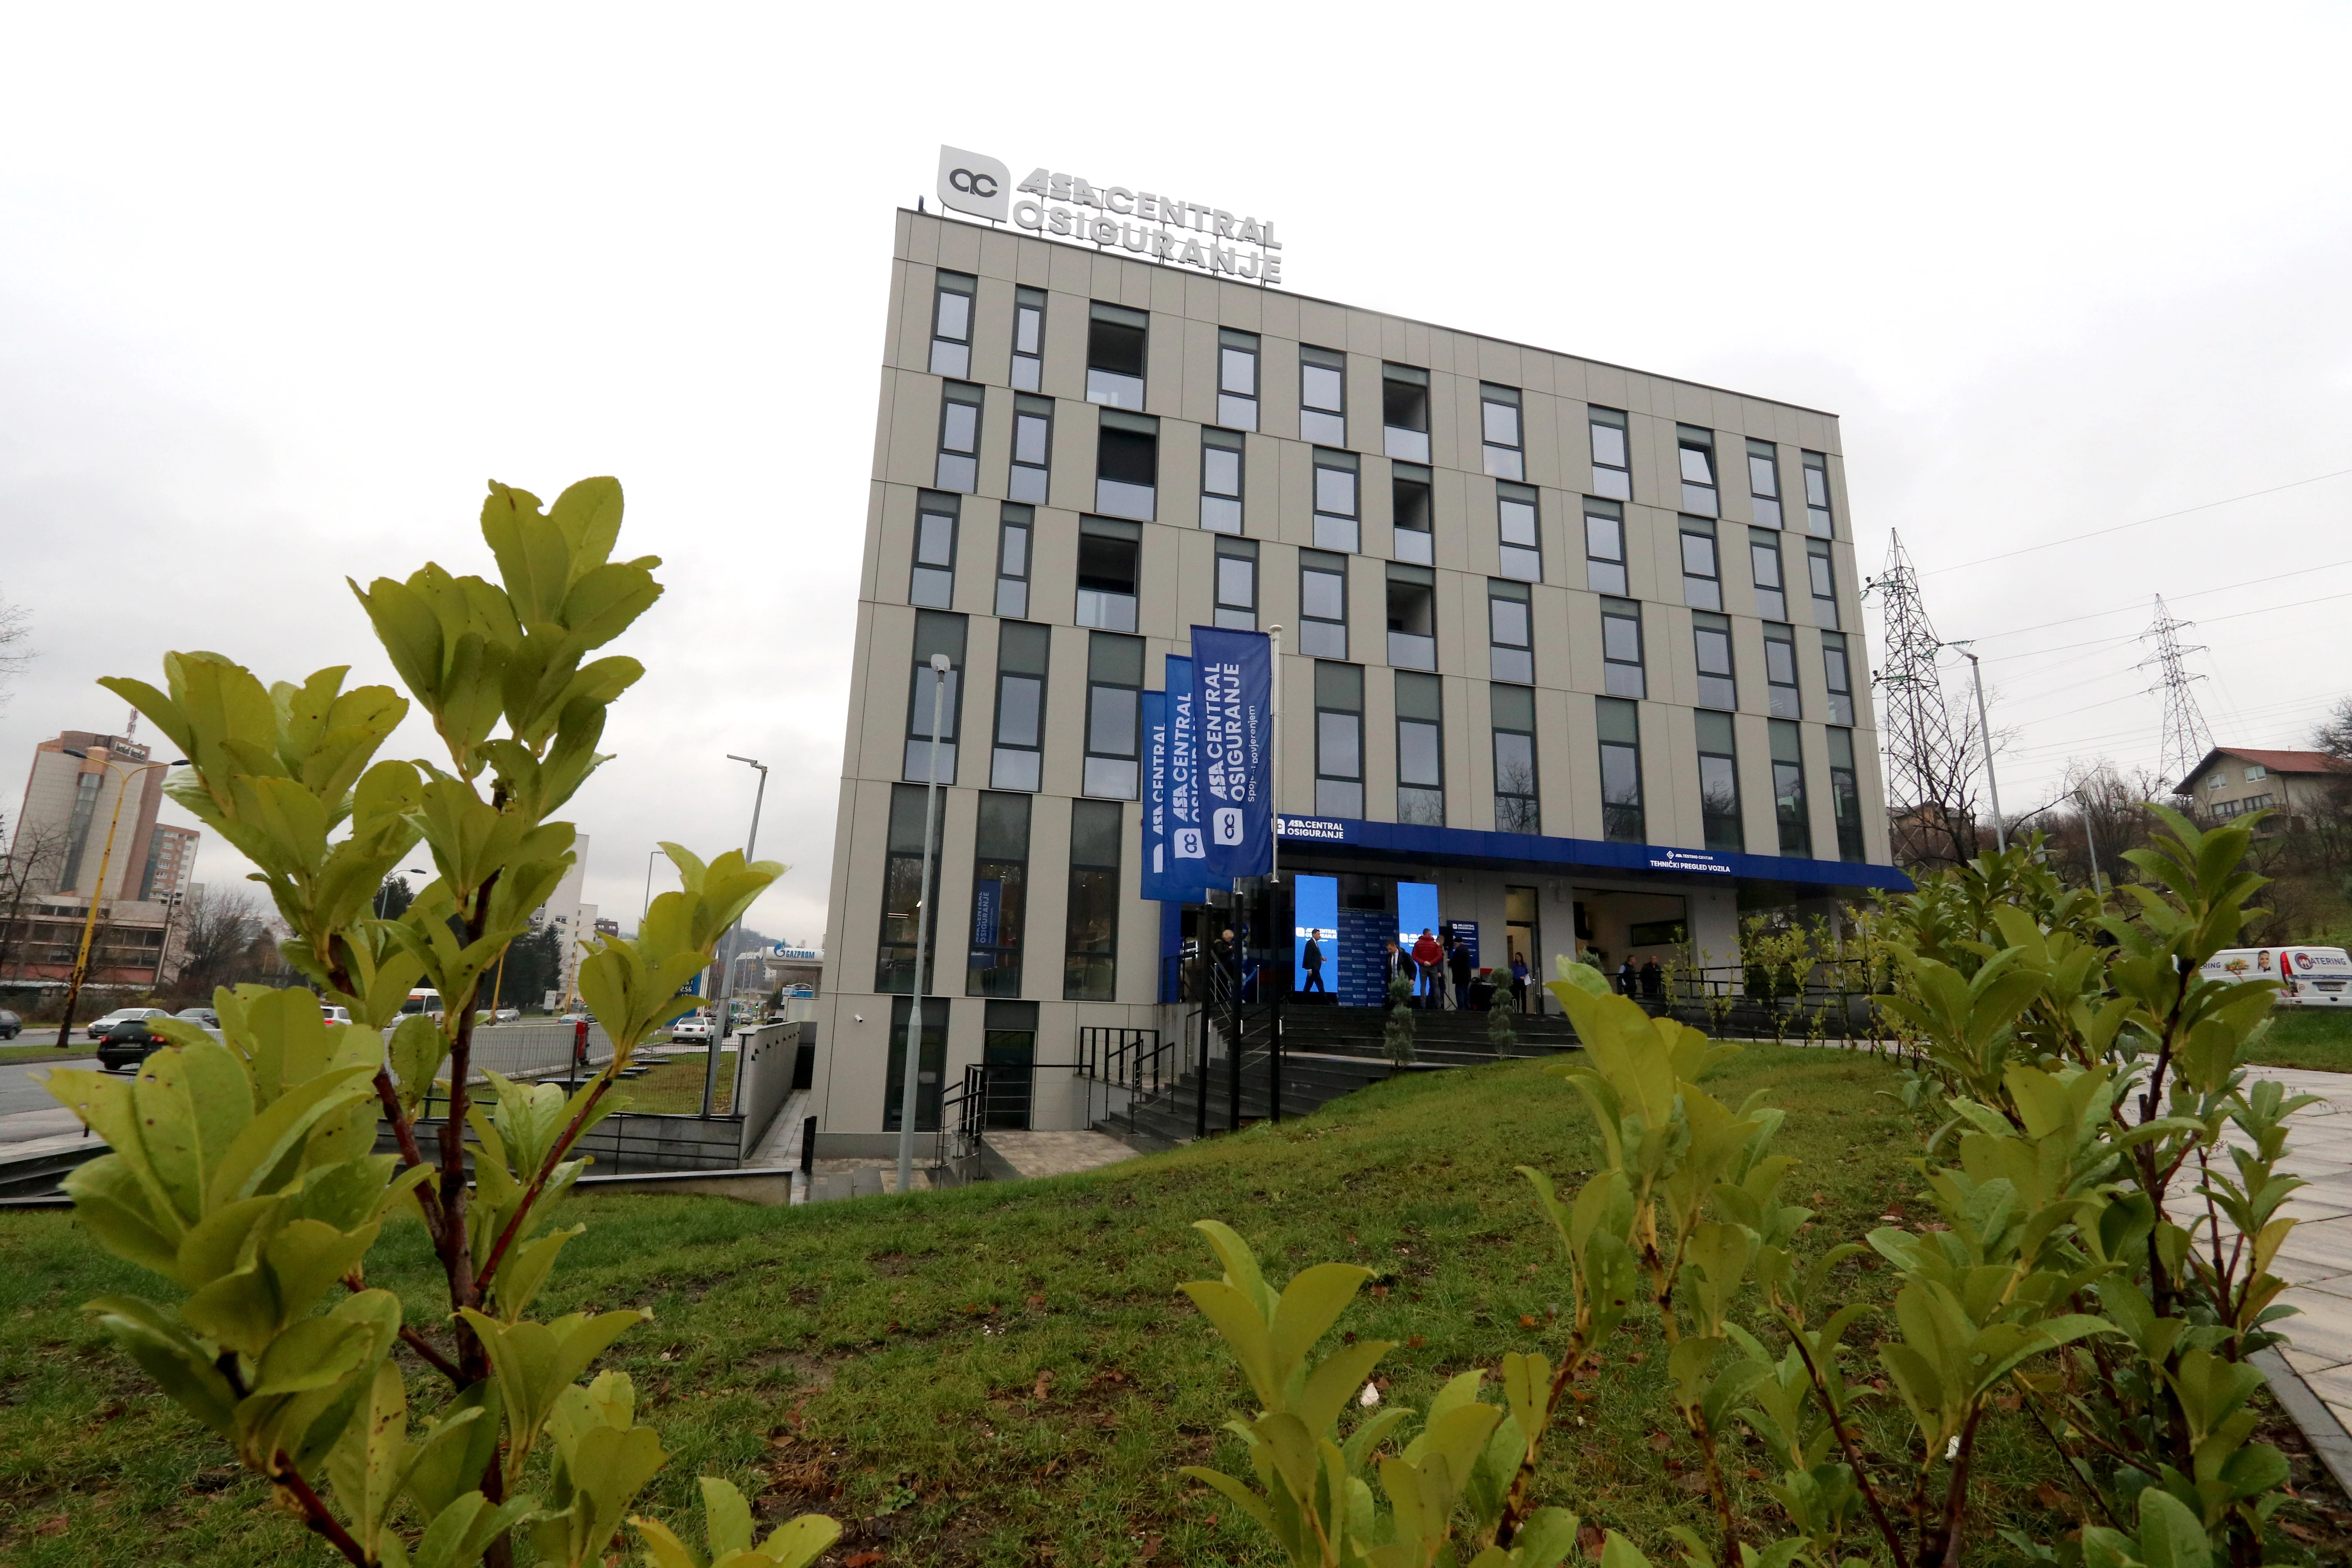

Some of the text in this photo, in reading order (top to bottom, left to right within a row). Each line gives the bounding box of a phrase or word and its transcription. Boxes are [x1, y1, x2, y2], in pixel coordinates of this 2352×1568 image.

[1016, 167, 1282, 250] ASA CENTRAL
[1013, 200, 1281, 284] OSIGURANJE
[1172, 692, 1191, 822] ASA CENTRAL
[1204, 662, 1227, 801] ASA CENTRAL
[1223, 663, 1246, 802] OSIGURANJE
[1248, 705, 1259, 764] povjerenjem
[1152, 804, 1163, 836] ASA
[1287, 819, 1305, 828] ASA
[1305, 820, 1344, 831] CENTRAL
[1287, 828, 1344, 839] OSIGURANJE
[1650, 860, 1680, 869] TEHNIČKI
[1680, 862, 1708, 871] PREGLED
[980, 892, 989, 943] OSIGURANJE
[786, 950, 815, 959] GAZPROM
